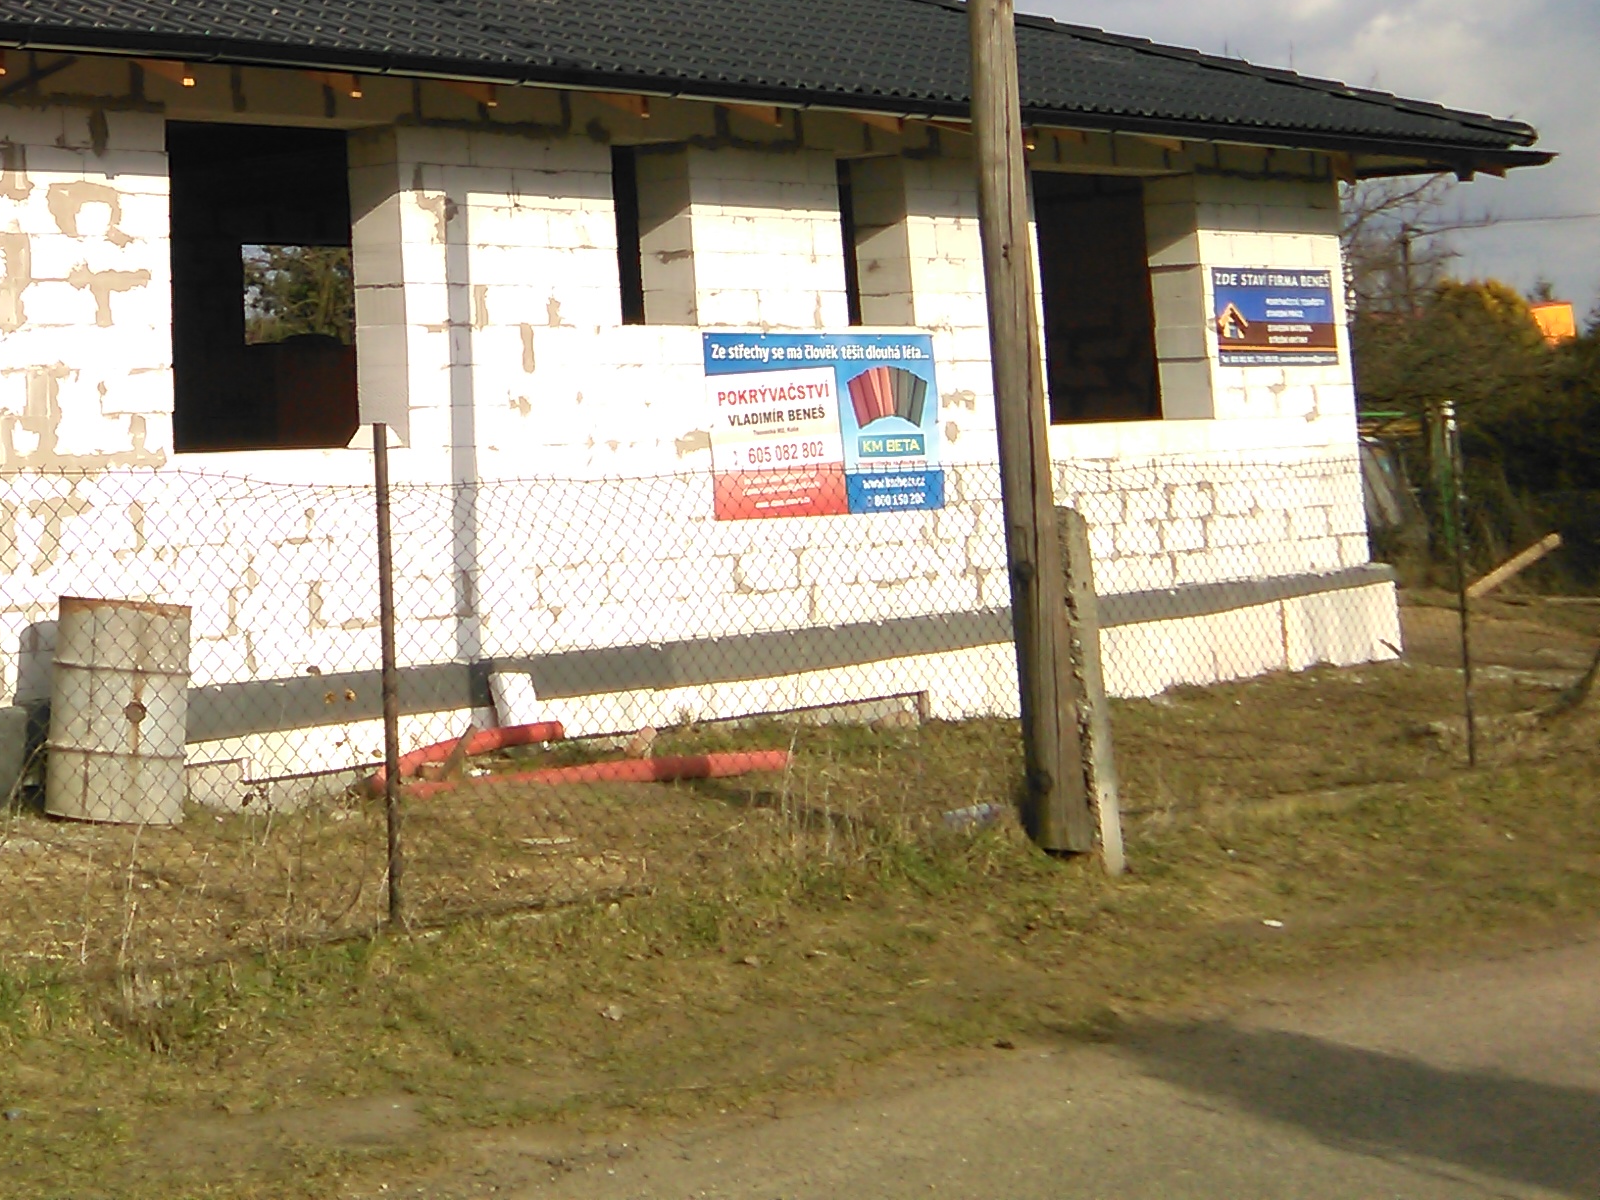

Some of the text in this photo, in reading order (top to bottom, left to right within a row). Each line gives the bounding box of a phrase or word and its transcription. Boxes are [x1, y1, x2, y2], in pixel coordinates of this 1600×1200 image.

[1215, 273, 1237, 286] ZDE
[1268, 273, 1299, 287] FIRMA
[1300, 273, 1330, 287] BENEŠ
[711, 343, 726, 359] Ze
[728, 343, 770, 363] střechy
[771, 346, 784, 359] se
[804, 344, 839, 360] člověk
[840, 344, 864, 359] těšit
[865, 344, 901, 359] dlouhá
[717, 379, 830, 406] POKRÝVAČSTVÍ
[728, 404, 825, 426] VLADIMÍR BENEŠ
[748, 440, 824, 464] 605 082 802
[862, 438, 920, 452] KM BETA
